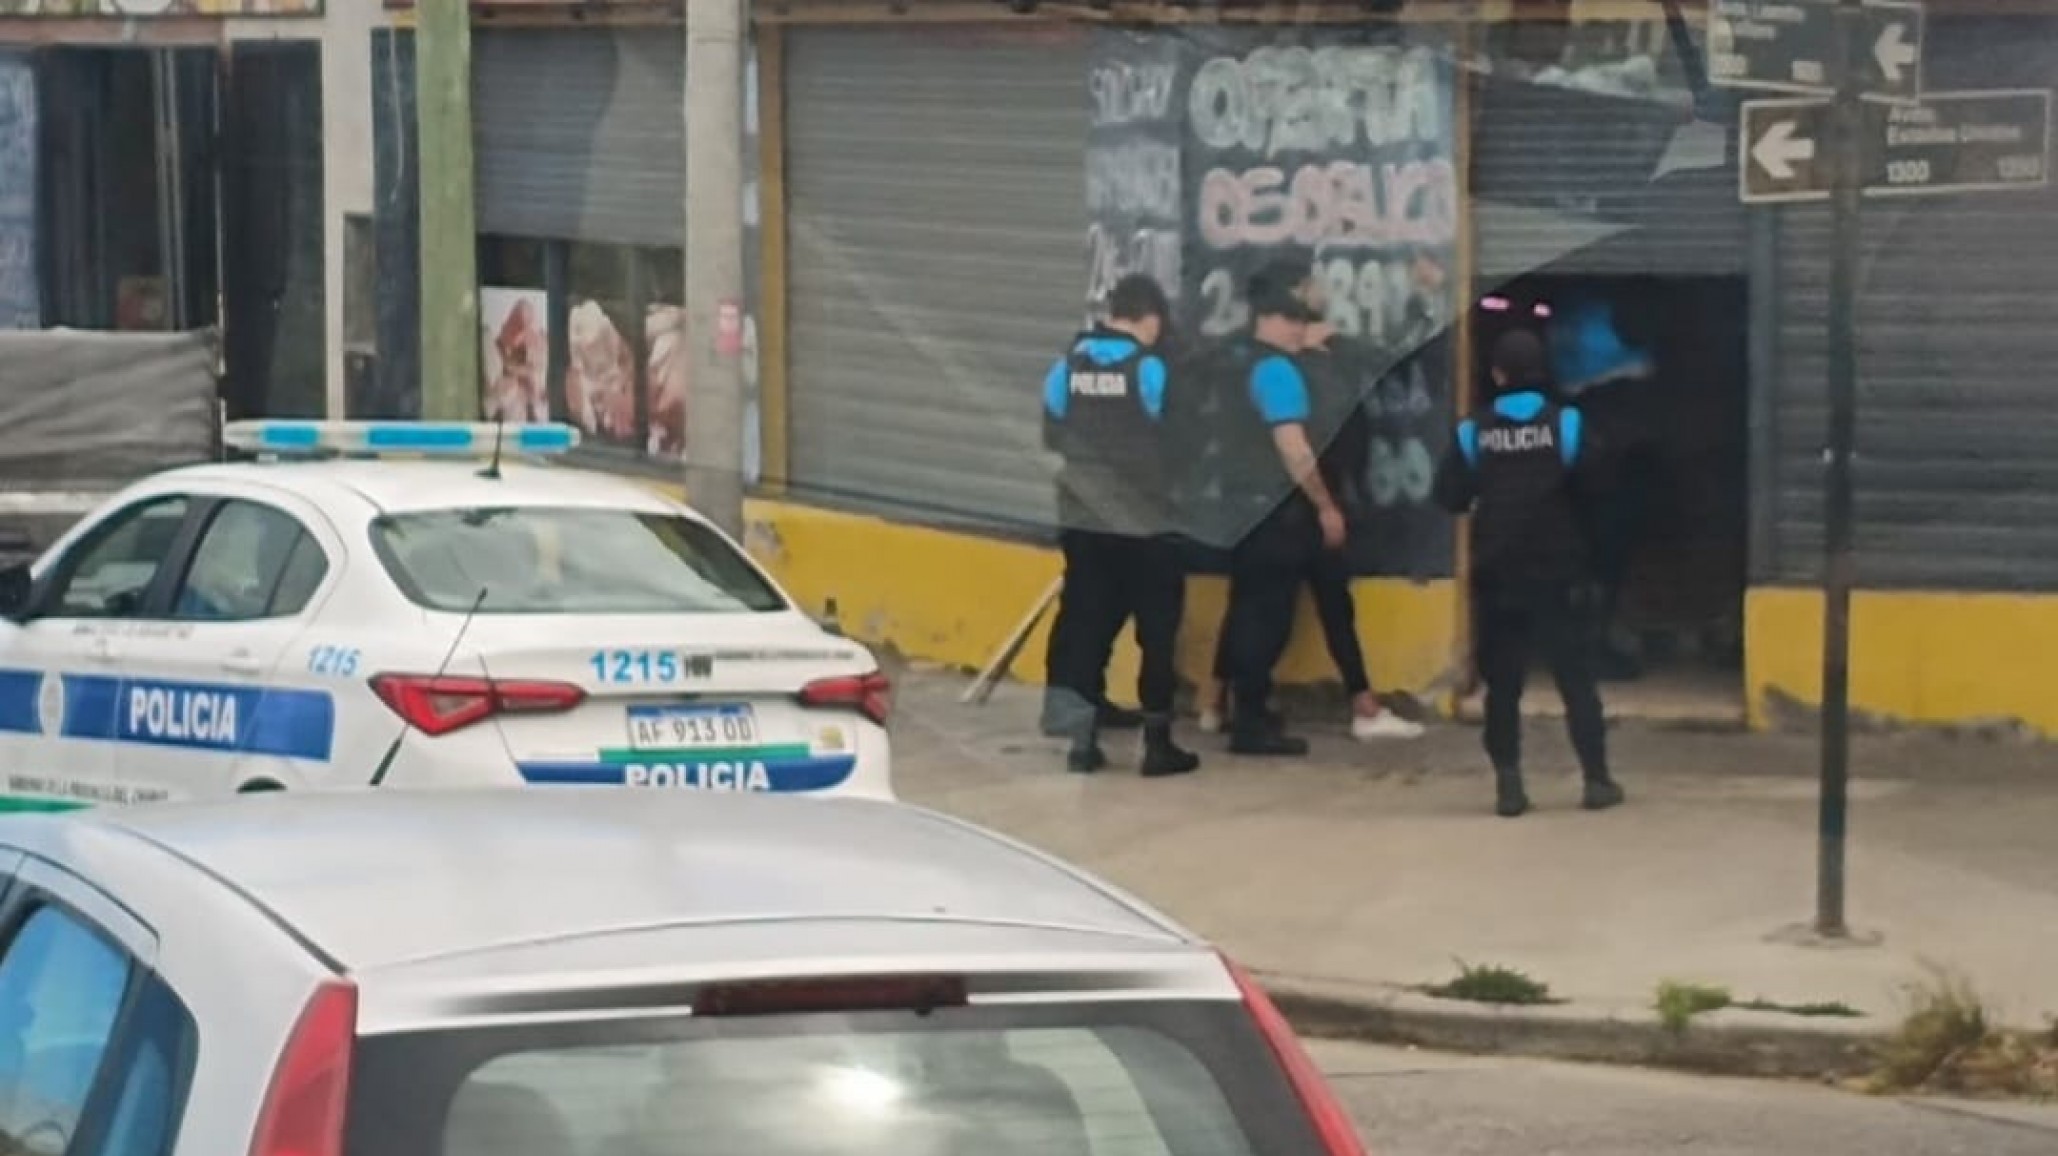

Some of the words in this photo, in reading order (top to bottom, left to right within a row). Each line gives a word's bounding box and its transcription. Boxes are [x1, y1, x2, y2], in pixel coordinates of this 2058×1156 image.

[1478, 424, 1554, 452] POLICIA
[308, 644, 361, 677] 1215
[589, 650, 678, 684] 1215
[128, 687, 237, 742] POLICIA
[623, 761, 772, 791] POLICIA
